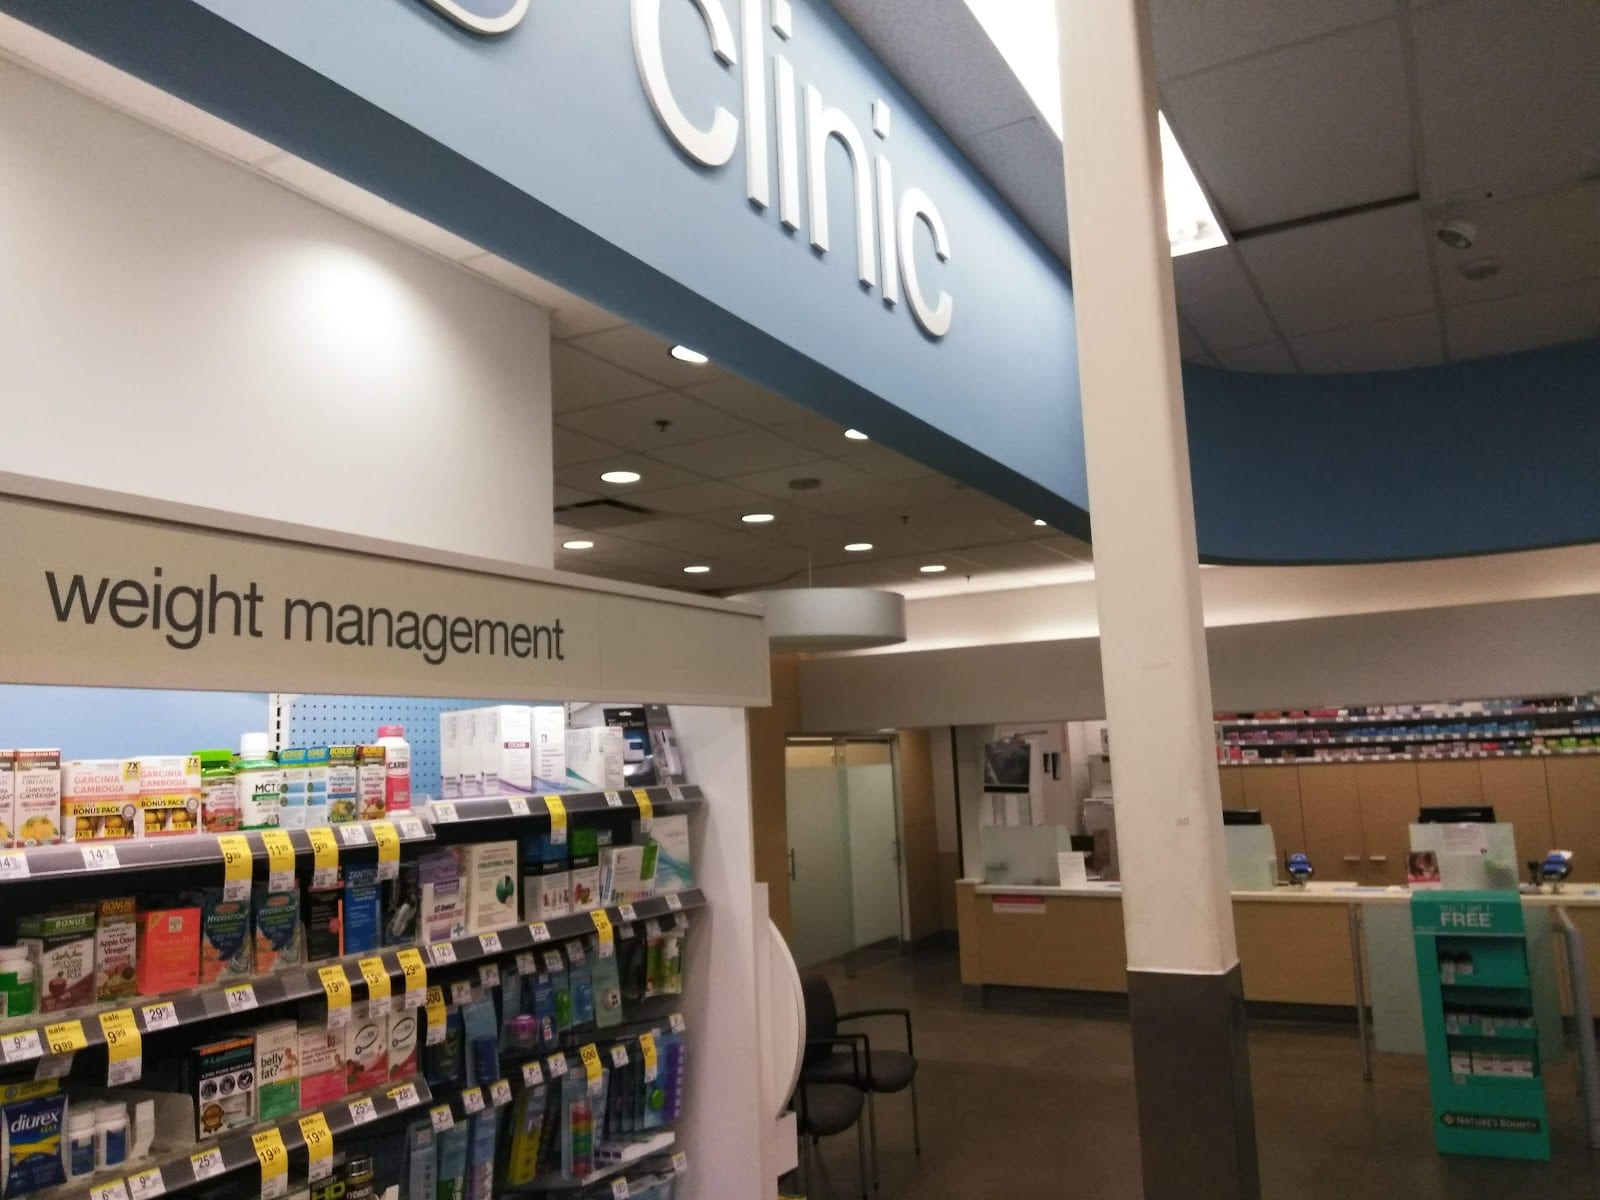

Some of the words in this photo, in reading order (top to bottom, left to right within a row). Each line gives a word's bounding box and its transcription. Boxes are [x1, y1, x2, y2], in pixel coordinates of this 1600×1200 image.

[45, 566, 263, 650] weight
[284, 596, 565, 665] management
[73, 775, 120, 785] GARCINIA
[73, 785, 125, 794] CAMBOGIA
[255, 783, 275, 793] MCT
[142, 799, 167, 808] BONUS
[168, 798, 184, 806] PACK
[73, 807, 100, 816] BONUS
[101, 806, 120, 814] PACK
[55, 917, 87, 928] BONUS
[1440, 911, 1492, 928] FREE
[103, 1013, 119, 1022] sale
[49, 1025, 66, 1034] sale
[260, 1052, 284, 1068] belly
[260, 1064, 280, 1081] fat?
[10, 1110, 59, 1133] diurex
